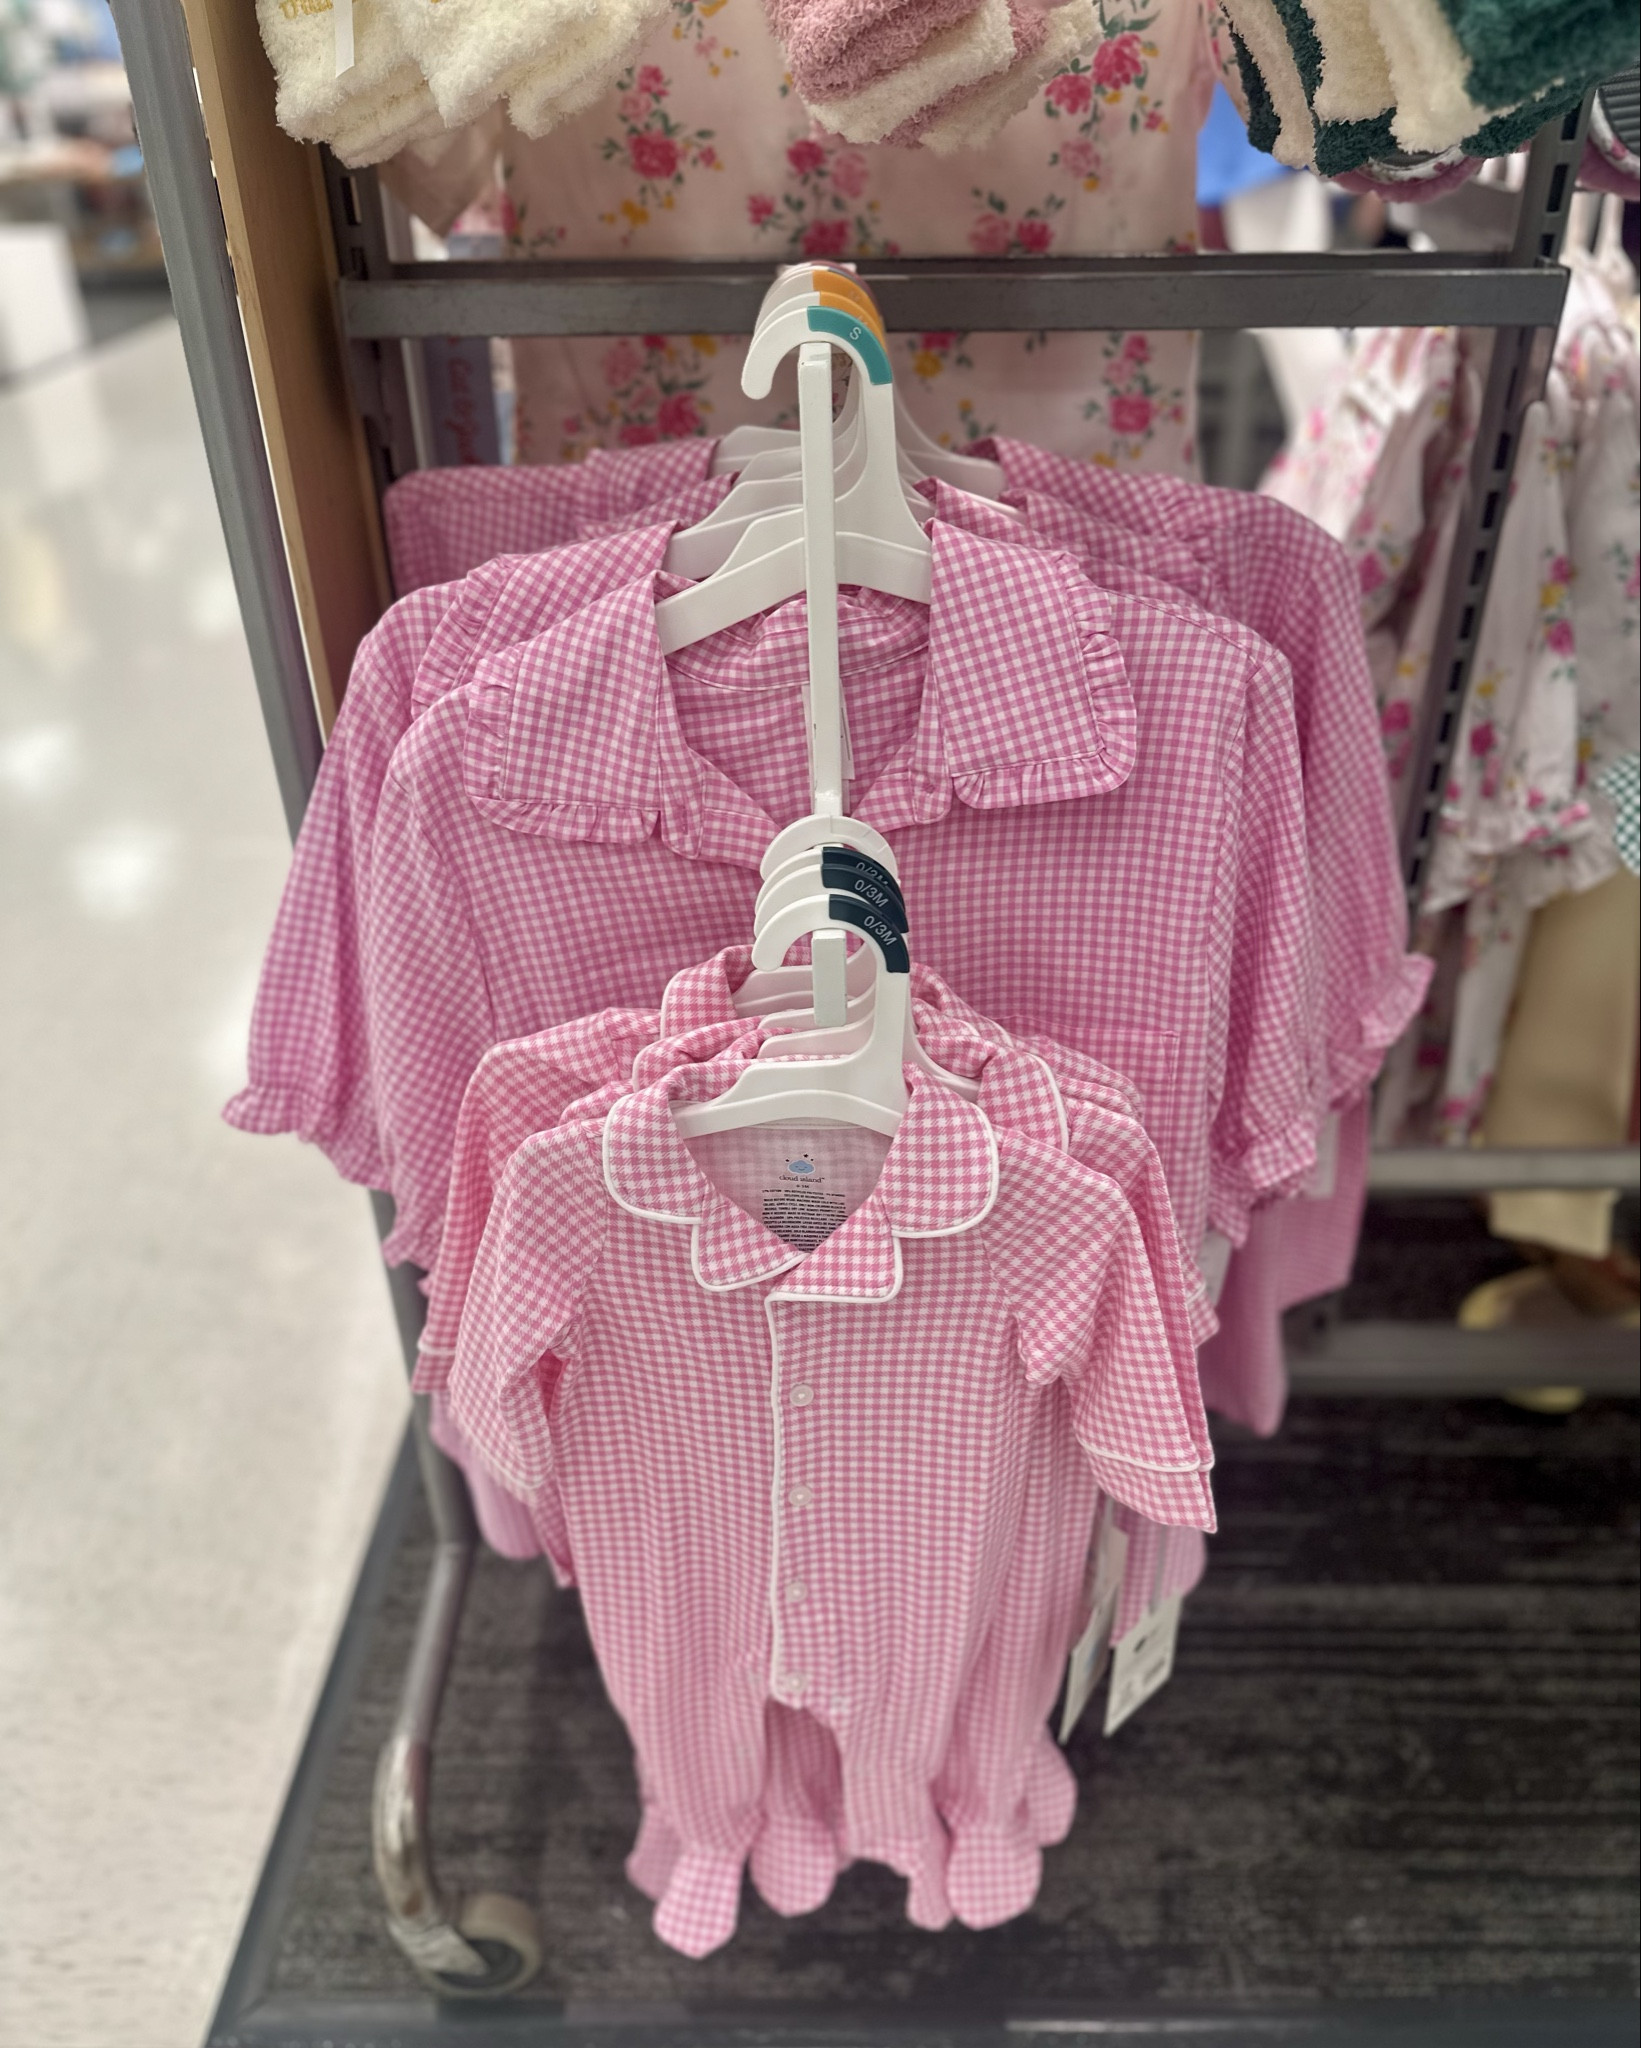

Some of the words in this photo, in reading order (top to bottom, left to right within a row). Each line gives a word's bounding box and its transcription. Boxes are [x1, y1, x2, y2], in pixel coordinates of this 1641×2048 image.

[849, 326, 862, 341] S
[854, 879, 889, 908] 0/3M
[864, 915, 897, 946] 0/3M
